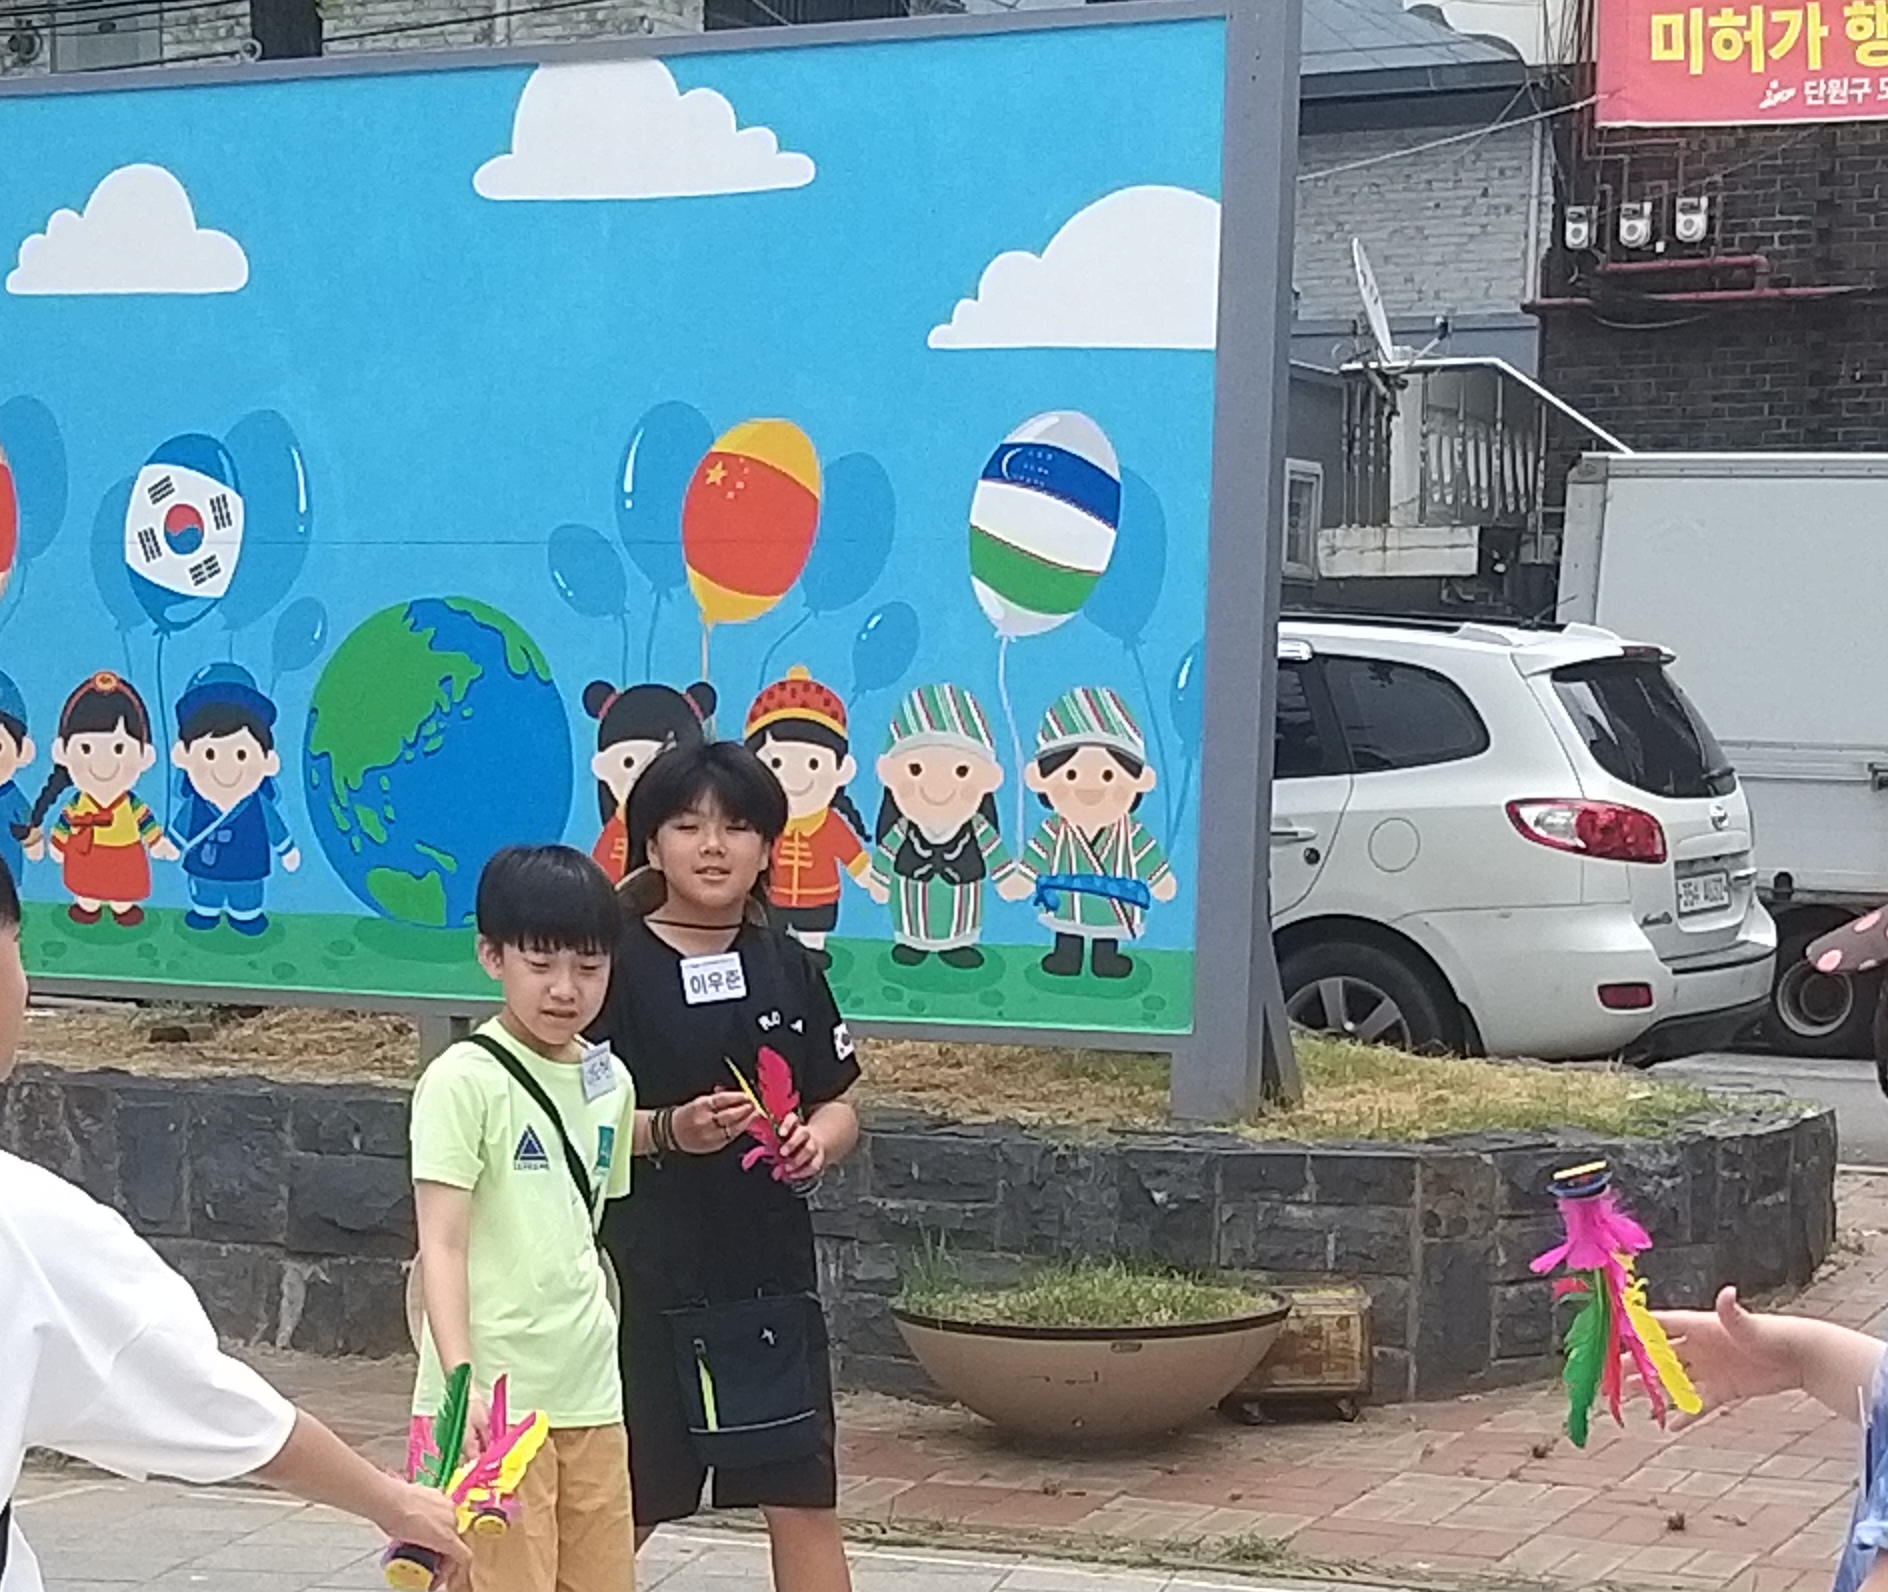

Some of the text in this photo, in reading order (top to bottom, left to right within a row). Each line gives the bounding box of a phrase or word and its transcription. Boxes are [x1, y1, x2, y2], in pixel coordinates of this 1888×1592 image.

[1651, 2, 1829, 74] 미허가
[1804, 78, 1872, 104] 단원구
[690, 969, 742, 995] 이우준
